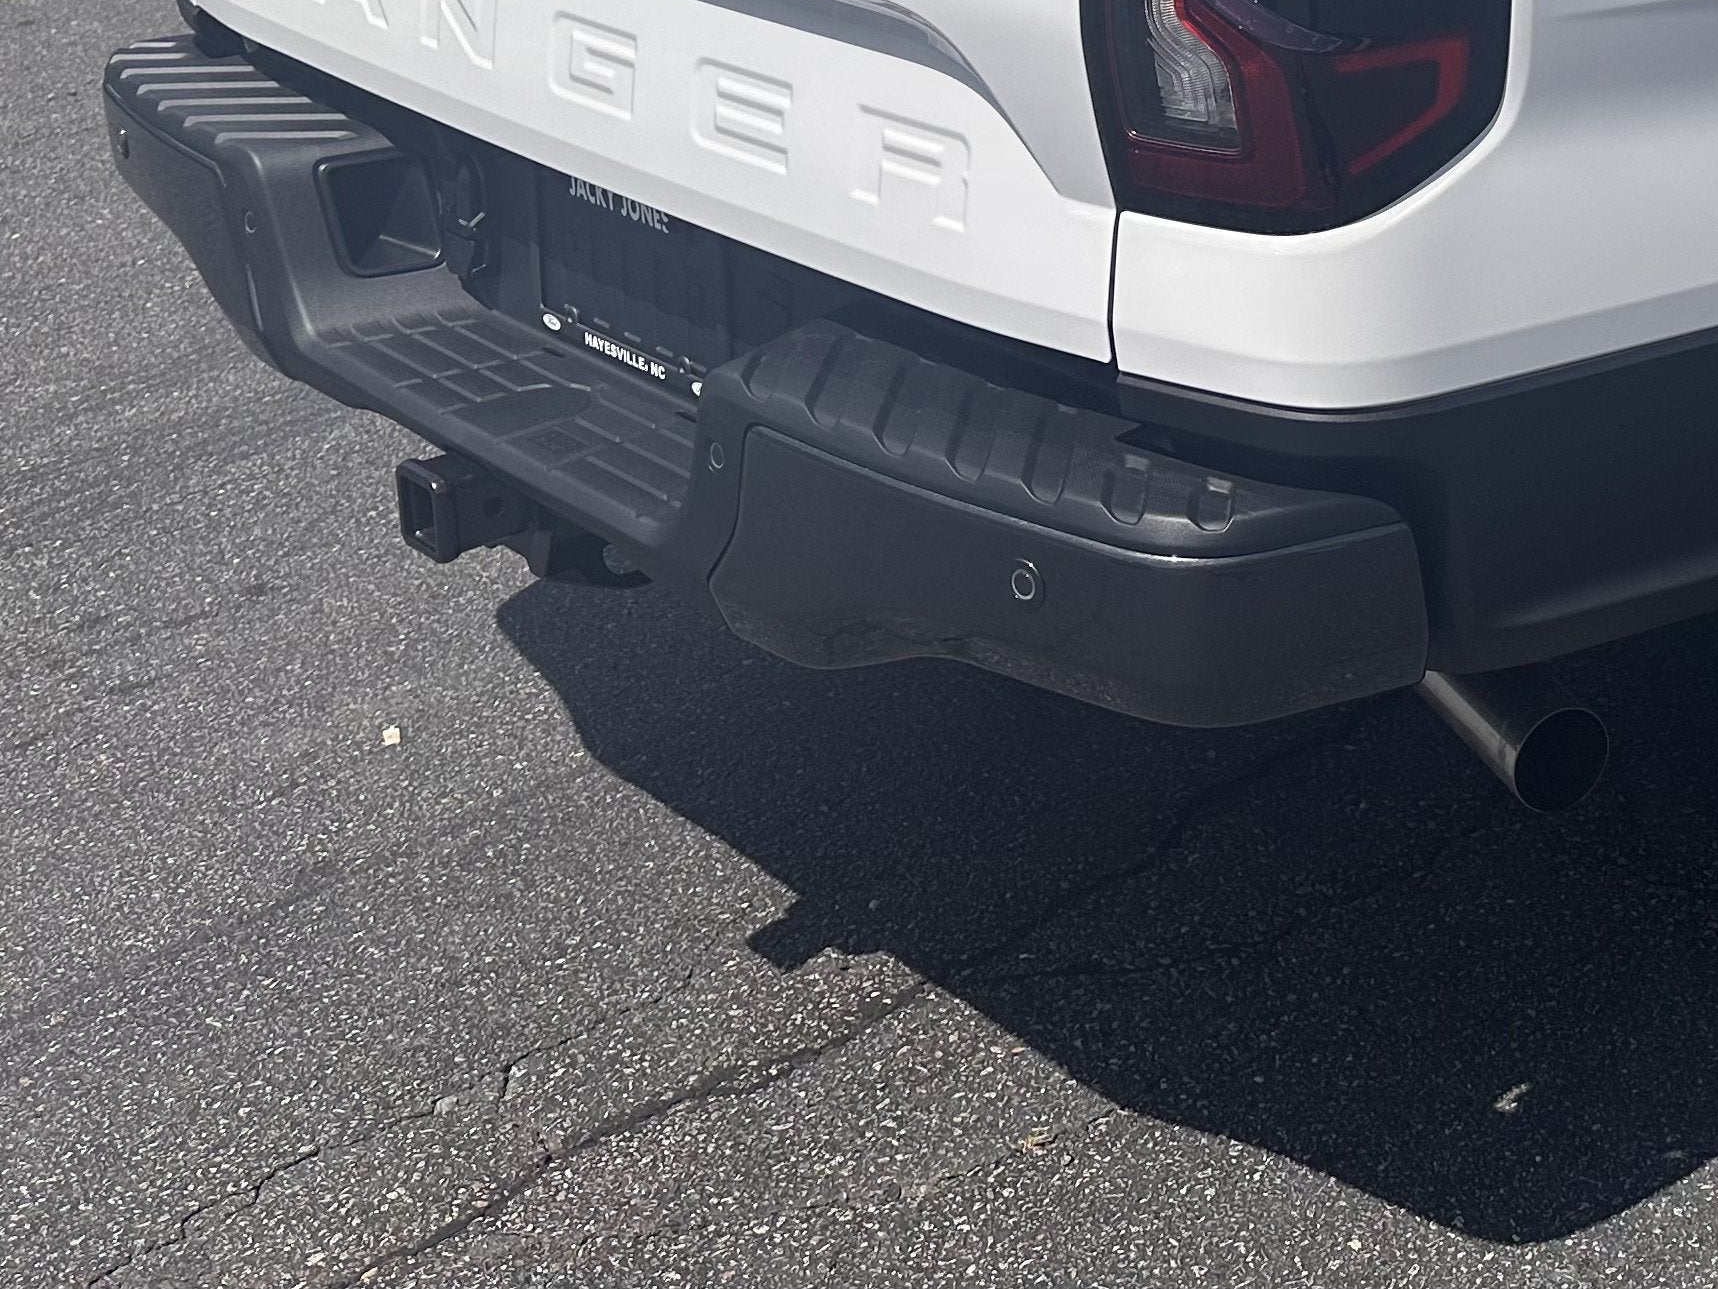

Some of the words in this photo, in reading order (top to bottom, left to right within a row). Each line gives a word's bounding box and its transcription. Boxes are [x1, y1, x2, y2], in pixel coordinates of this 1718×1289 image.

[569, 176, 614, 211] JACKY
[584, 331, 649, 372] HAYESVILLE,
[650, 361, 667, 380] NC
